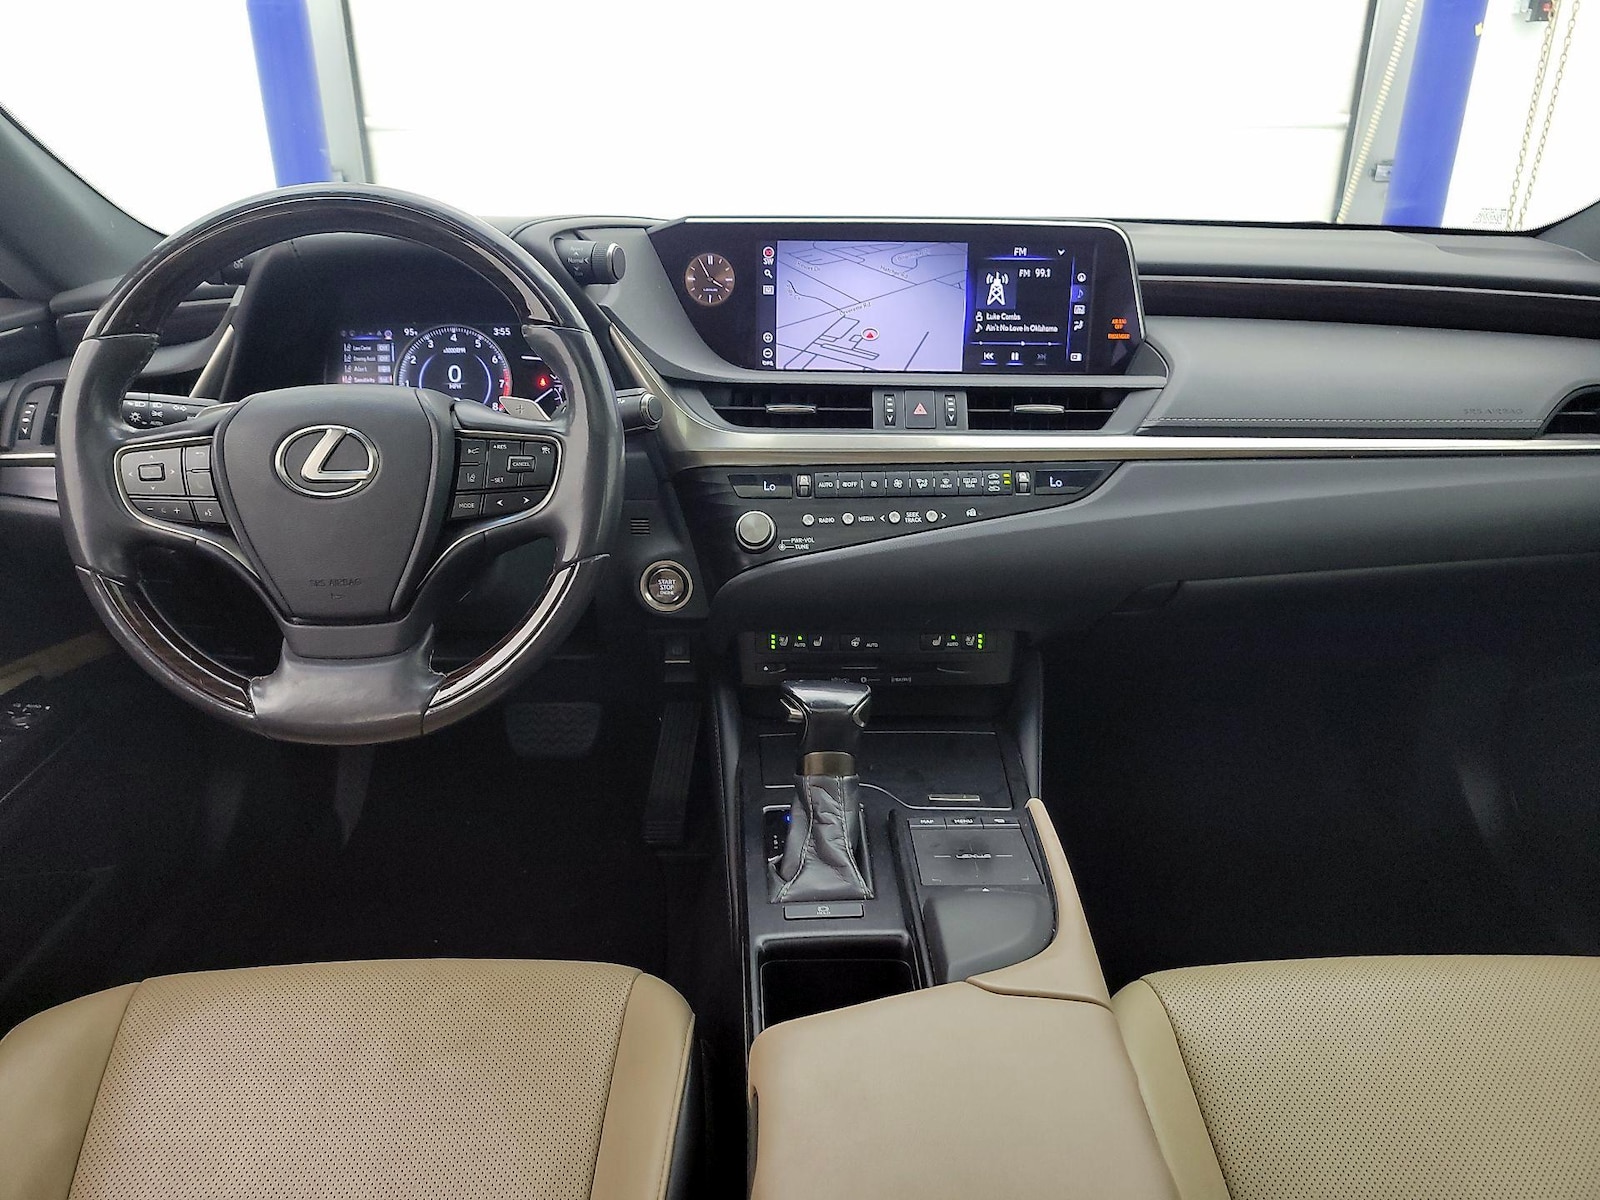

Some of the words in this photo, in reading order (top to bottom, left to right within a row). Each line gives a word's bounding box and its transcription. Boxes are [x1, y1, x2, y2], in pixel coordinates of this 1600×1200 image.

[1013, 247, 1028, 256] FM
[1018, 268, 1031, 278] FM
[1035, 268, 1051, 278] 99.1
[986, 312, 1000, 320] Luke
[1001, 312, 1021, 320] Combs
[493, 327, 511, 336] 3:55
[985, 324, 999, 332] Ain't
[1000, 324, 1009, 332] No
[1009, 324, 1023, 332] Love
[1030, 324, 1058, 332] Oklahoma
[450, 333, 457, 341] 4
[428, 340, 434, 348] 3
[475, 340, 481, 348] 5
[410, 356, 417, 364] 2
[492, 355, 498, 364] 6
[448, 365, 462, 382] 0
[499, 379, 505, 388] 7
[492, 402, 498, 411] 8
[762, 480, 776, 492] Lo
[1050, 476, 1063, 488] Lo
